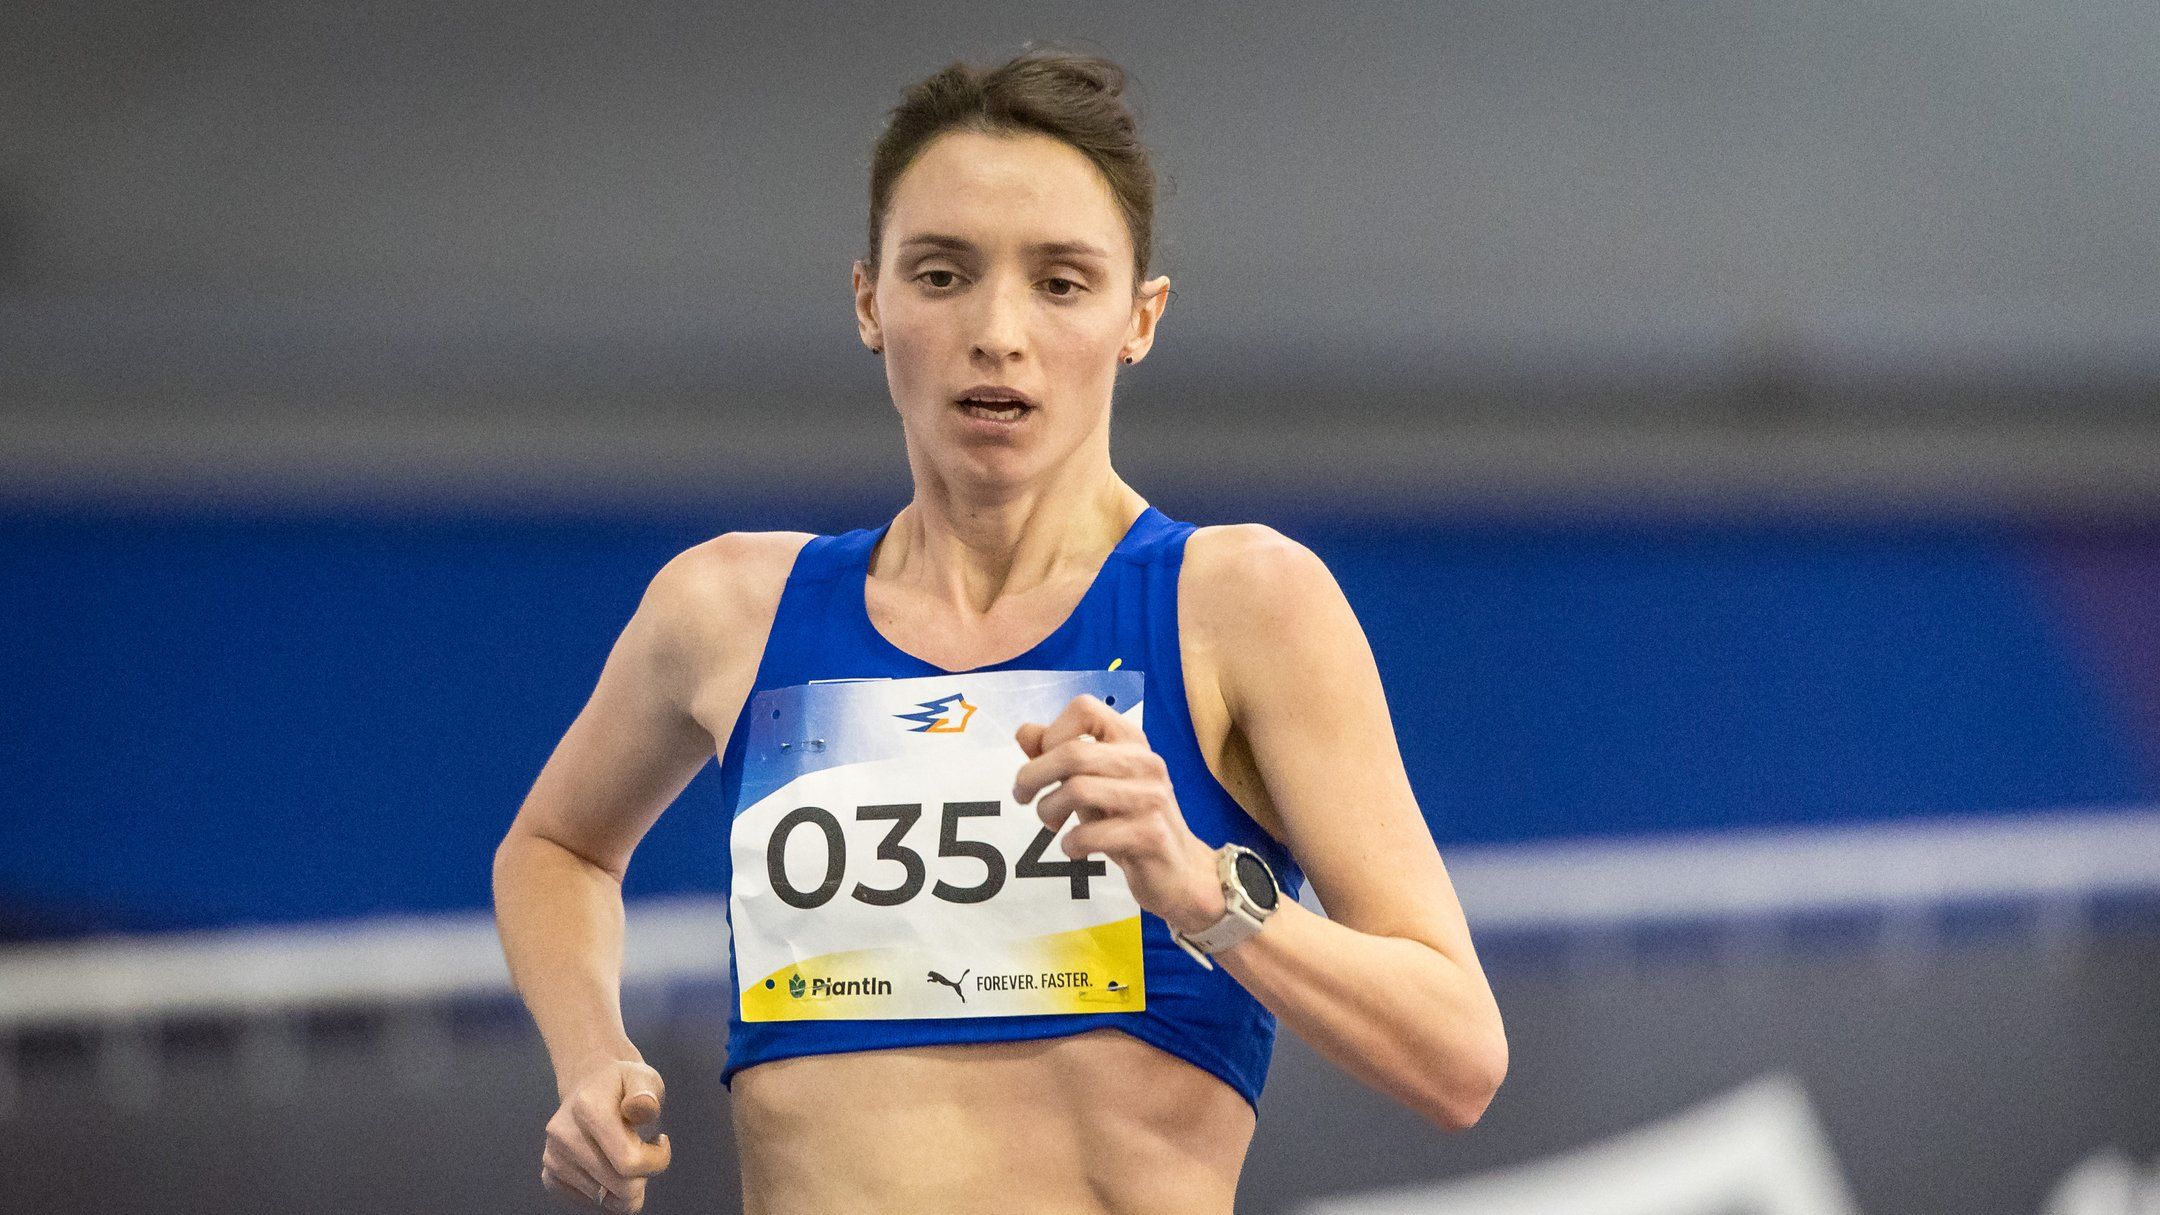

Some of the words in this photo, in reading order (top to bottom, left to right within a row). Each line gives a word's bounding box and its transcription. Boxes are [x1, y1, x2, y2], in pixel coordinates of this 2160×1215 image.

[767, 801, 1106, 909] 0354
[976, 974, 1038, 992] FOREVER.
[1041, 972, 1094, 989] FASTER.
